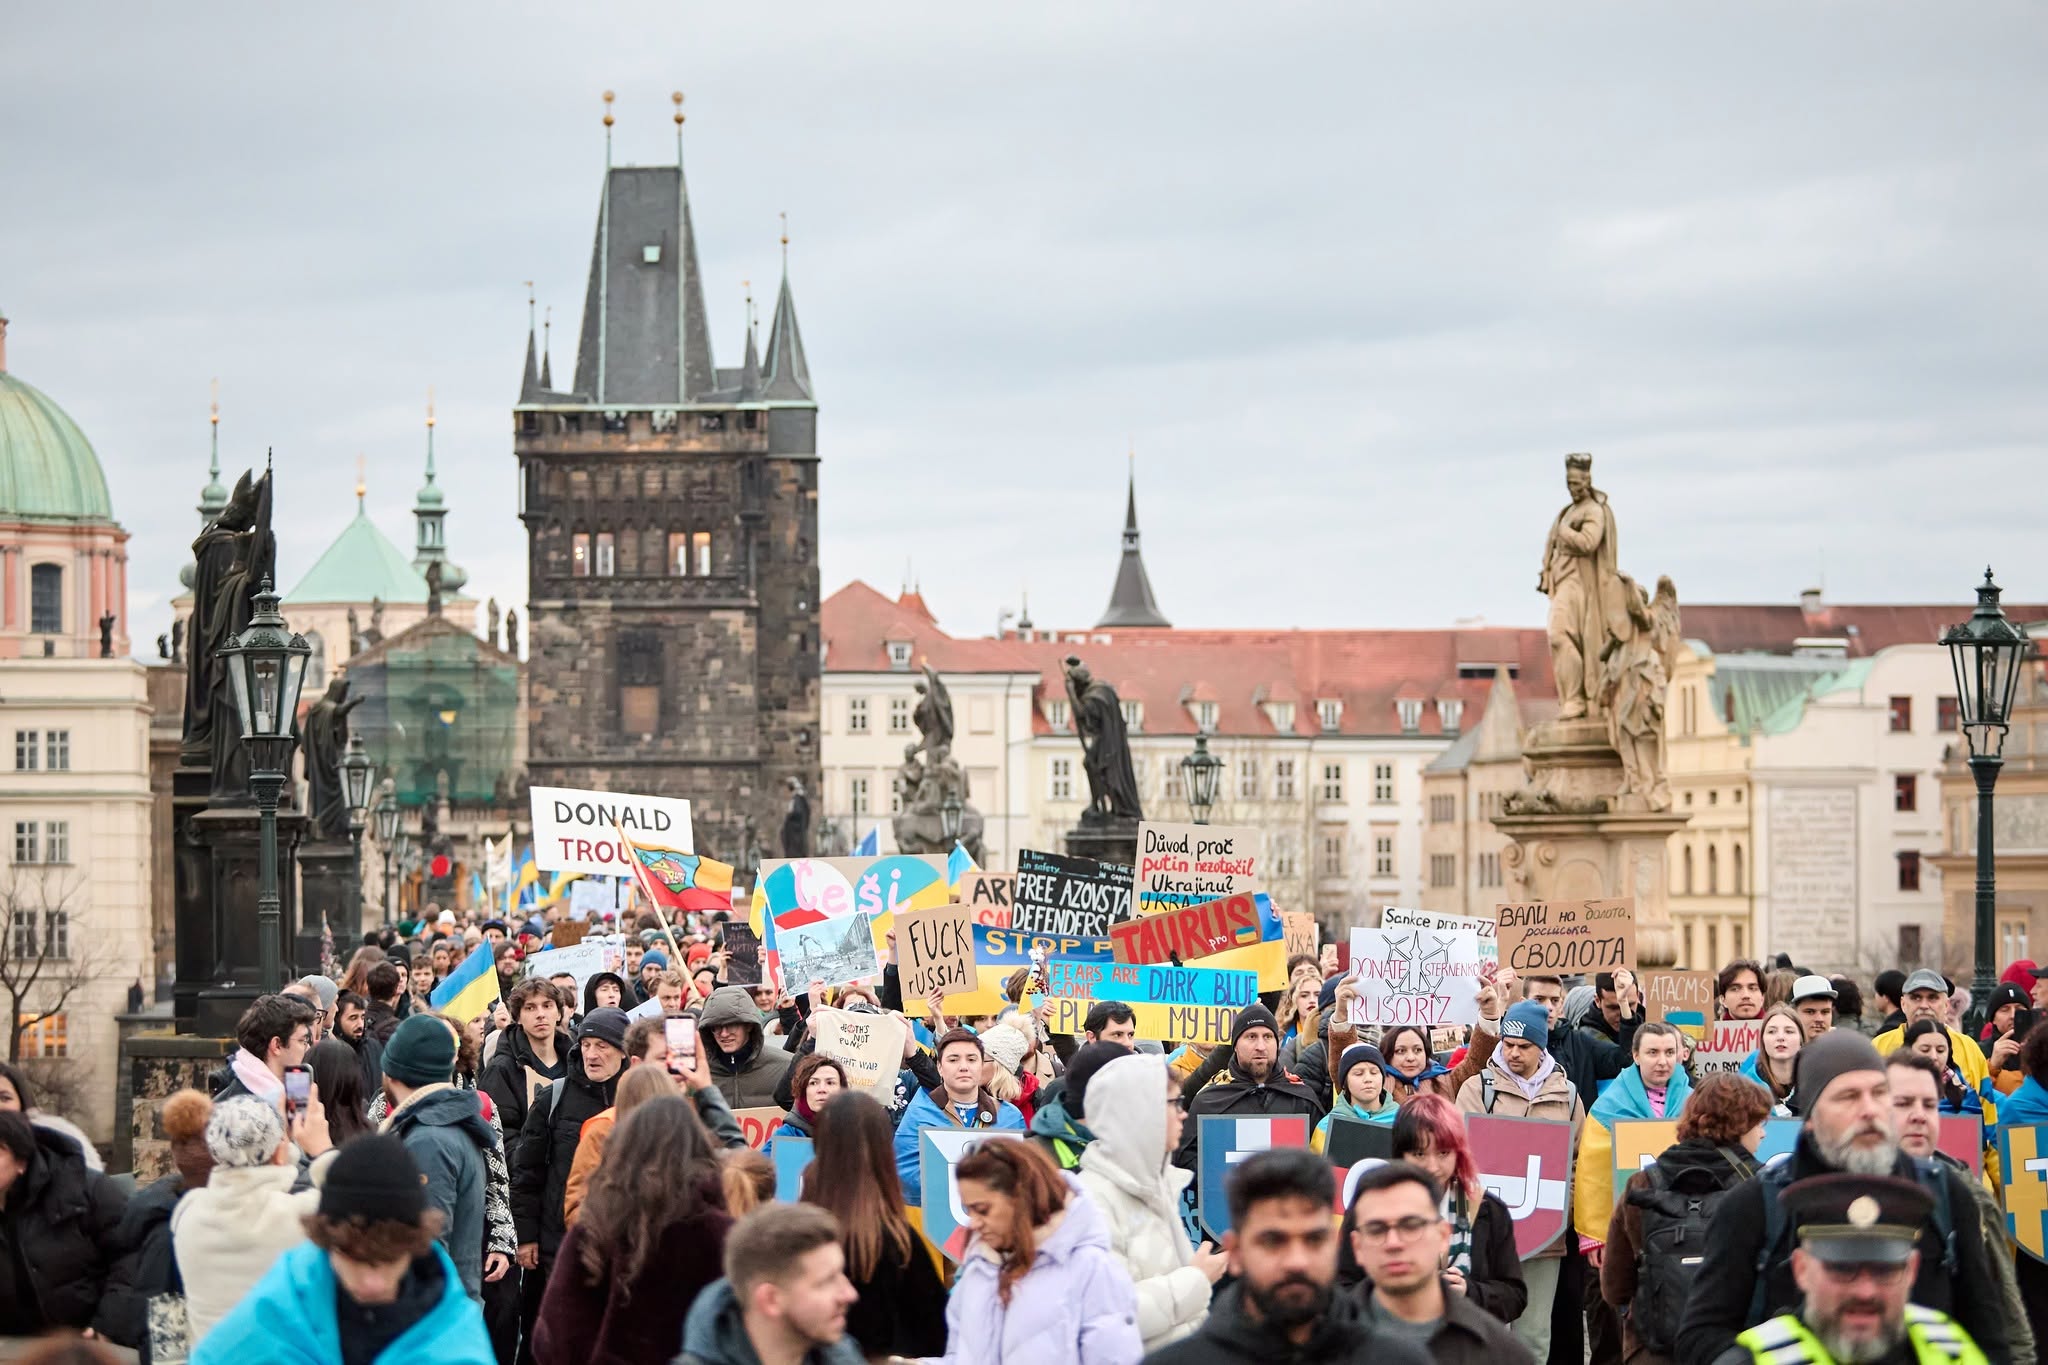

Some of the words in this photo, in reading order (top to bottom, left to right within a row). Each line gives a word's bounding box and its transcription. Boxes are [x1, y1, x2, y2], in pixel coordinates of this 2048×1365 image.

[555, 800, 671, 831] DONALD
[1145, 829, 1193, 857] Důvod,
[1196, 838, 1233, 861] proč
[1142, 855, 1188, 882] putin
[1015, 872, 1057, 902] FREE
[1151, 874, 1234, 897] Ukrajinu?
[1385, 908, 1431, 928] Sankce
[1437, 919, 1458, 930] pro
[1499, 905, 1548, 928] ВАЛИ
[1559, 909, 1576, 922] на
[908, 919, 969, 967] FUCK
[985, 930, 1081, 956] STOP
[1111, 896, 1257, 966] TAURUS
[1208, 933, 1228, 951] pro
[1510, 936, 1625, 970] СВОЛОТА
[1052, 964, 1102, 983] FEARS
[1111, 967, 1140, 985] ARE
[1350, 957, 1407, 980] DONATE
[1150, 969, 1198, 1004] DARK
[1649, 975, 1710, 1004] ATACMS
[1169, 1007, 1199, 1040] MY
[853, 1034, 870, 1044] NOT
